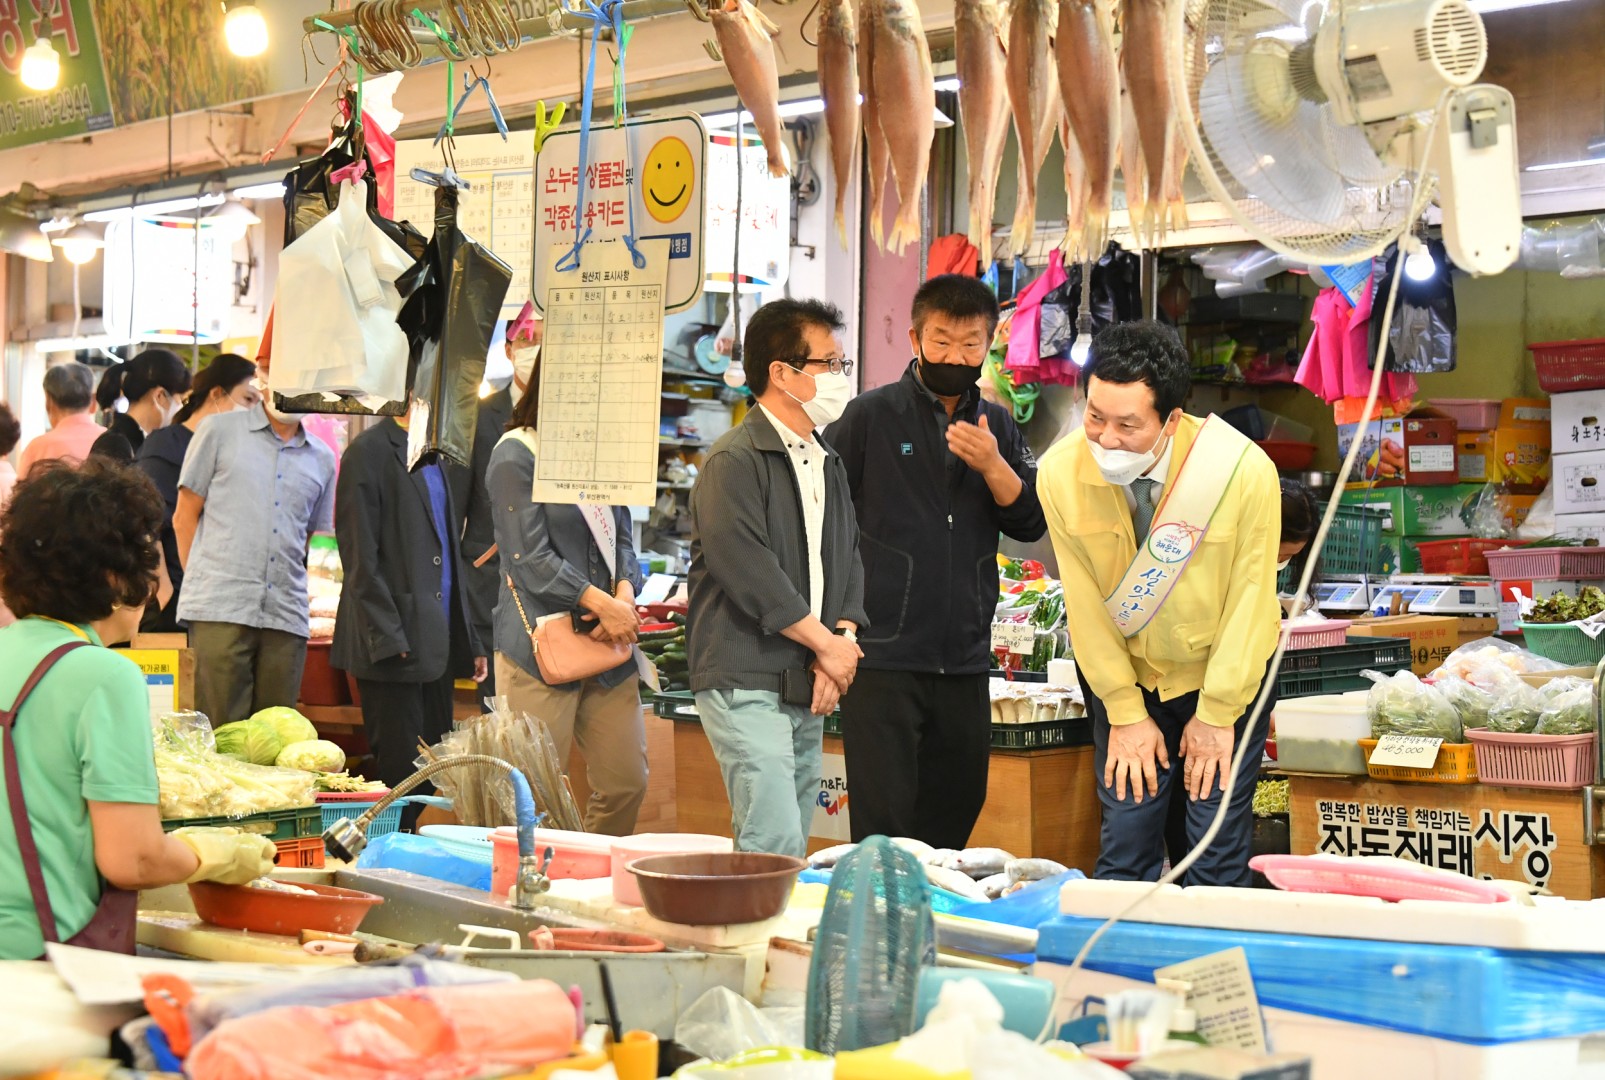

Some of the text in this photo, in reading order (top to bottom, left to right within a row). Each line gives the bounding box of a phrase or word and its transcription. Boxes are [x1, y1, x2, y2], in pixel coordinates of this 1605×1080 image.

[581, 270, 630, 283] 원산지 표시사항
[584, 291, 602, 301] 원산지
[641, 289, 658, 299] 원산지
[1155, 540, 1182, 555] 해운대
[1430, 646, 1451, 662] 식품
[1319, 801, 1471, 832] 행복한 밥상을 책임지는
[1474, 812, 1554, 879] 시장
